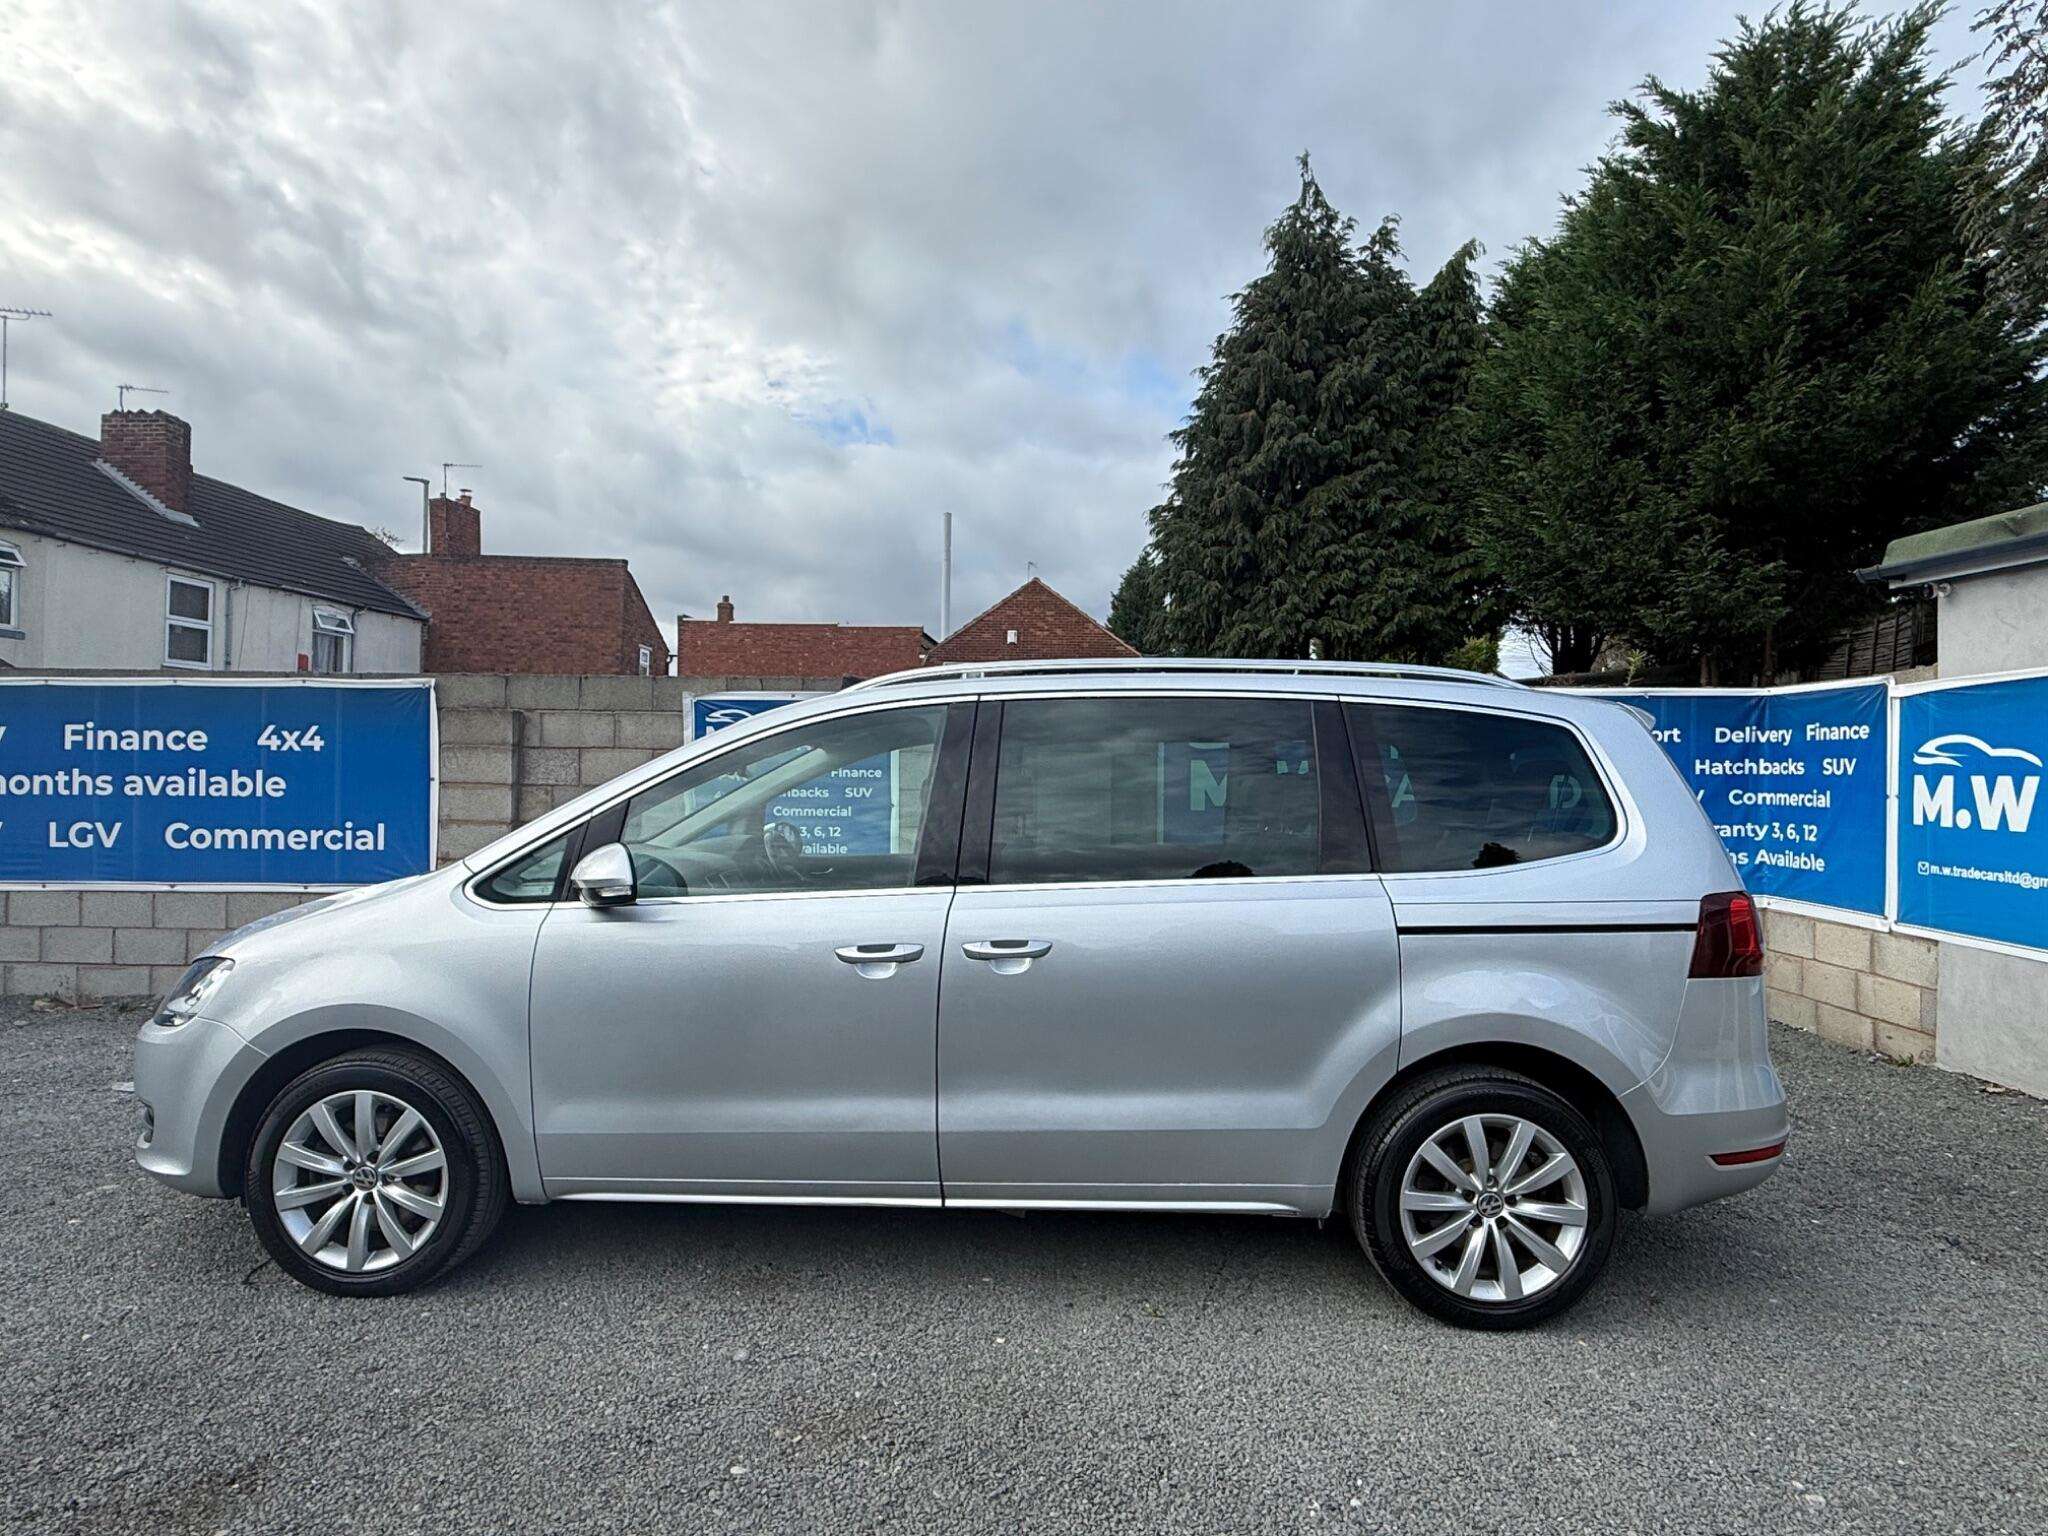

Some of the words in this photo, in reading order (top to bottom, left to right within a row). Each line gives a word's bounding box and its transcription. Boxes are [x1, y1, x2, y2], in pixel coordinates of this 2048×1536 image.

[64, 721, 208, 751] Finance
[257, 724, 325, 751] 4x4
[1651, 727, 1681, 743] ort
[1715, 725, 1793, 746] Delivery
[1806, 722, 1870, 741] Finance
[1695, 758, 1805, 776] Hatchbacks
[1822, 757, 1857, 776] SUV
[0, 768, 113, 795] onths
[123, 767, 287, 797] available
[845, 787, 872, 798] SUV
[1728, 788, 1831, 808] Commercial
[773, 805, 852, 817] Commercial
[1912, 774, 2041, 833] M.W
[49, 821, 122, 848] LGV
[164, 821, 385, 851] Commercial
[828, 826, 841, 837] 12
[1803, 824, 1818, 842] 12
[802, 842, 848, 855] ailable
[1754, 849, 1826, 873] Available
